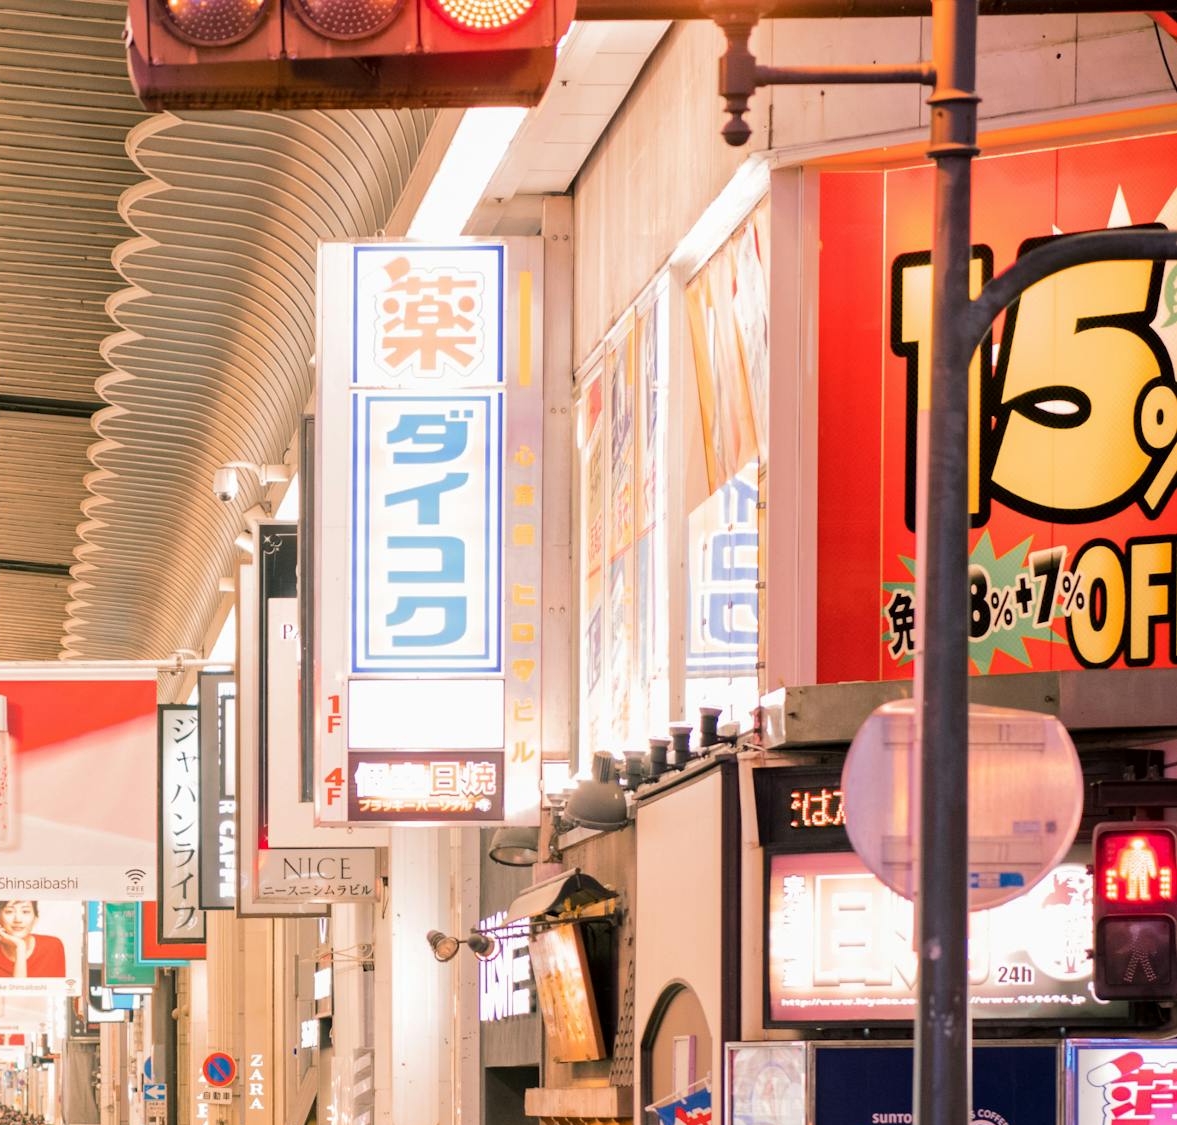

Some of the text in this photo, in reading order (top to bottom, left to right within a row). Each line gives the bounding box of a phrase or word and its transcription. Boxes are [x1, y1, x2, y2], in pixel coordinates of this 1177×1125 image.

[371, 257, 479, 372] 薬
[384, 409, 475, 647] ダイコク
[1067, 538, 1177, 670] OF
[283, 857, 353, 880] NICE
[997, 965, 1032, 983] 24h
[249, 1054, 264, 1110] ZARA
